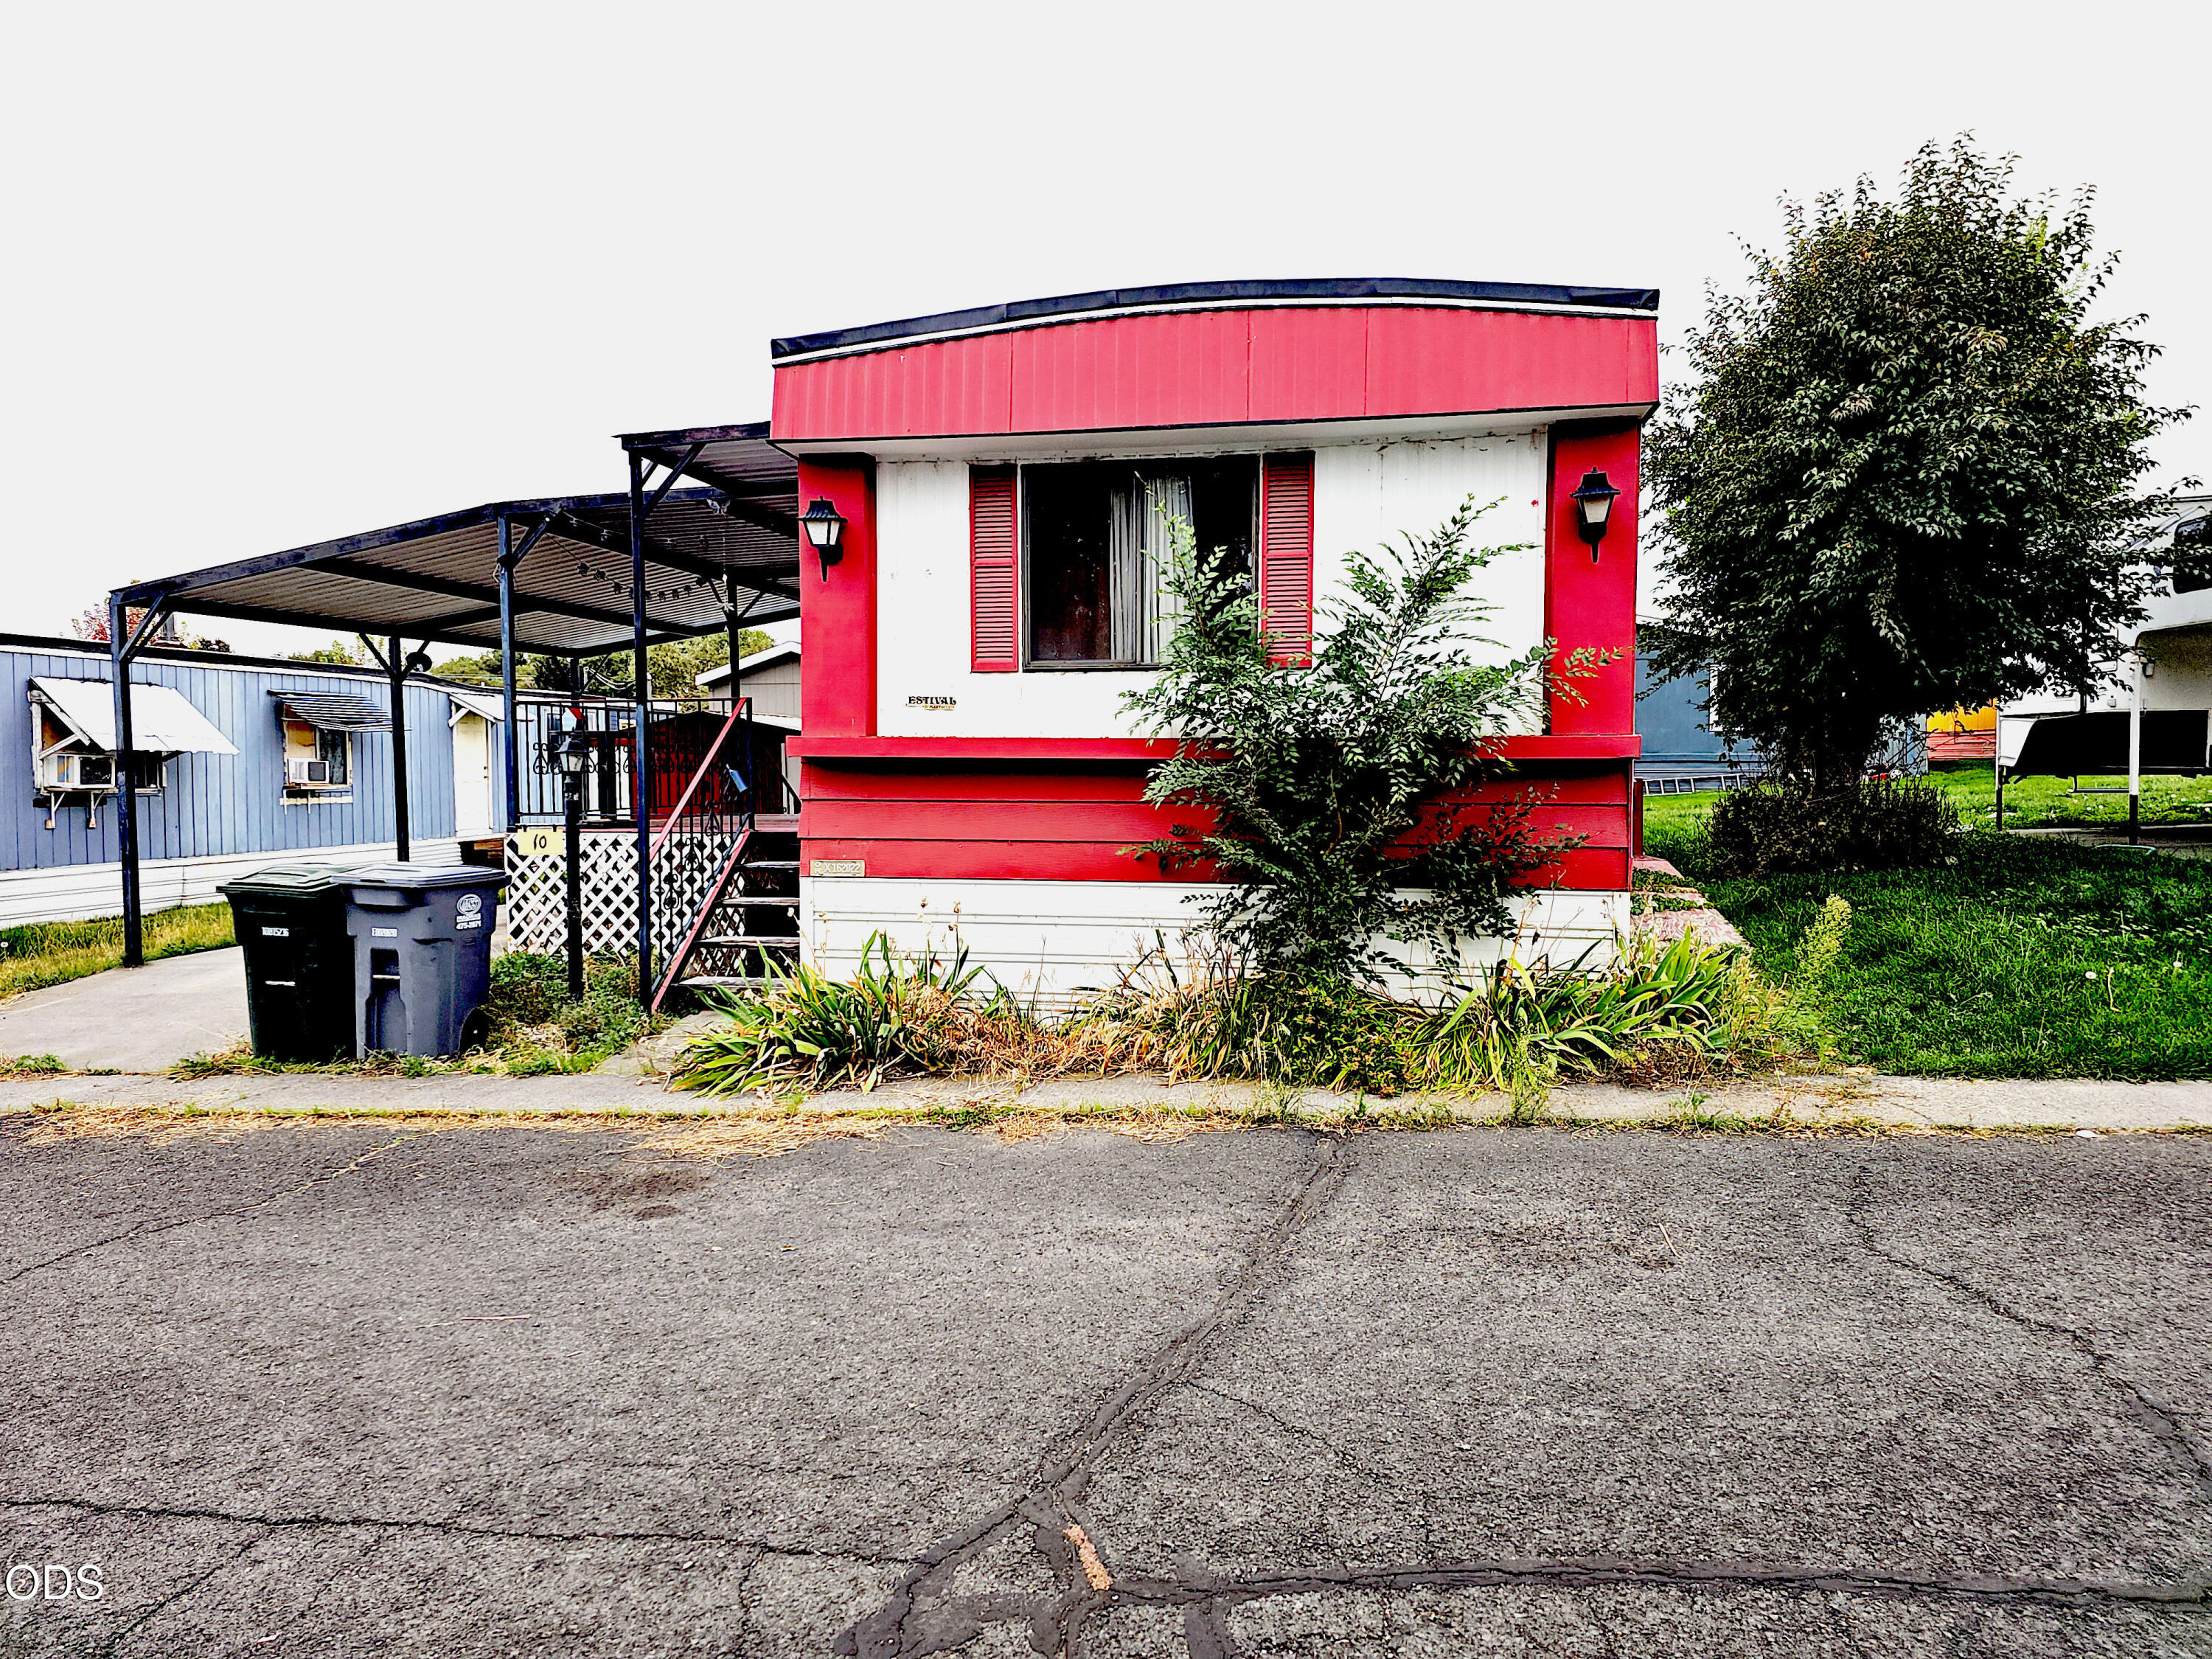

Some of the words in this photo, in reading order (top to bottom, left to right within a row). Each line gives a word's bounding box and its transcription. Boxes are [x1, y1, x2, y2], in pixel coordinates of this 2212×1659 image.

[908, 695, 956, 705] ESTIVAL
[534, 834, 546, 850] 10
[824, 862, 861, 873] X162022
